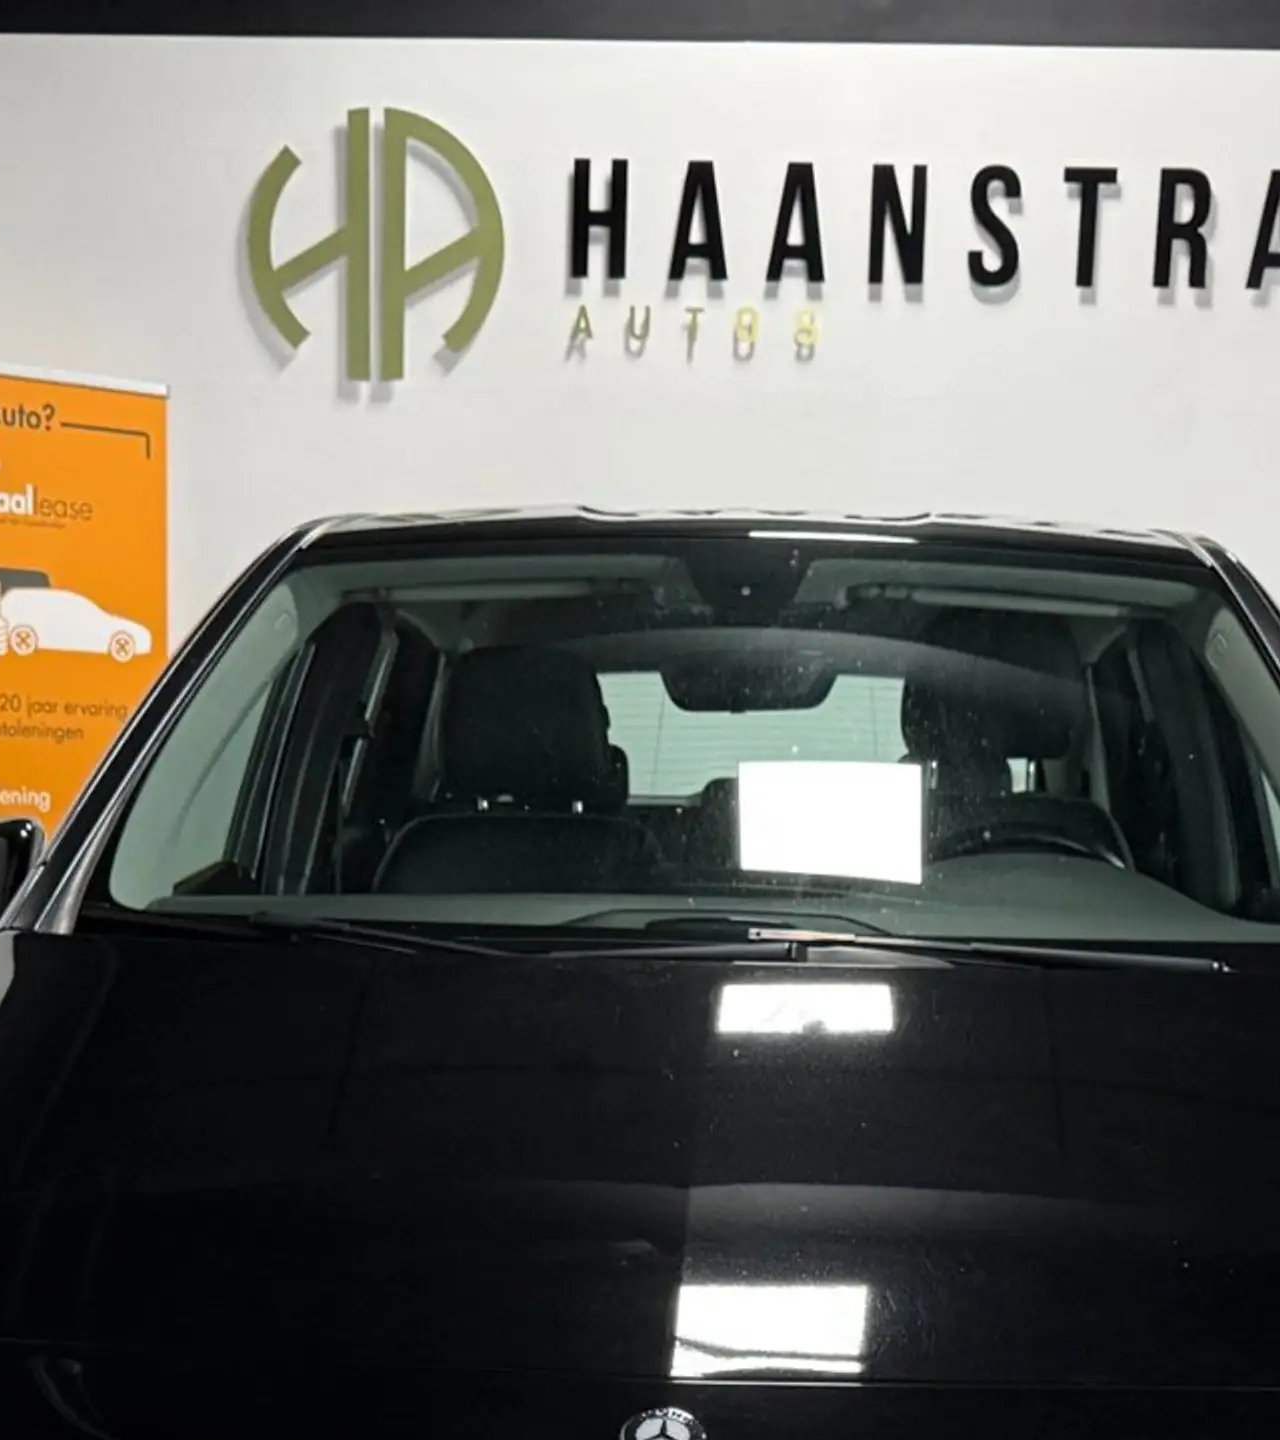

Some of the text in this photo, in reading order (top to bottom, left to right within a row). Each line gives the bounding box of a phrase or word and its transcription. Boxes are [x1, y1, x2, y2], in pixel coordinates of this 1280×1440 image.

[570, 304, 818, 347] AUTOS
[0, 694, 21, 713] 20
[26, 695, 58, 717] jaar
[64, 701, 128, 722] ervaring
